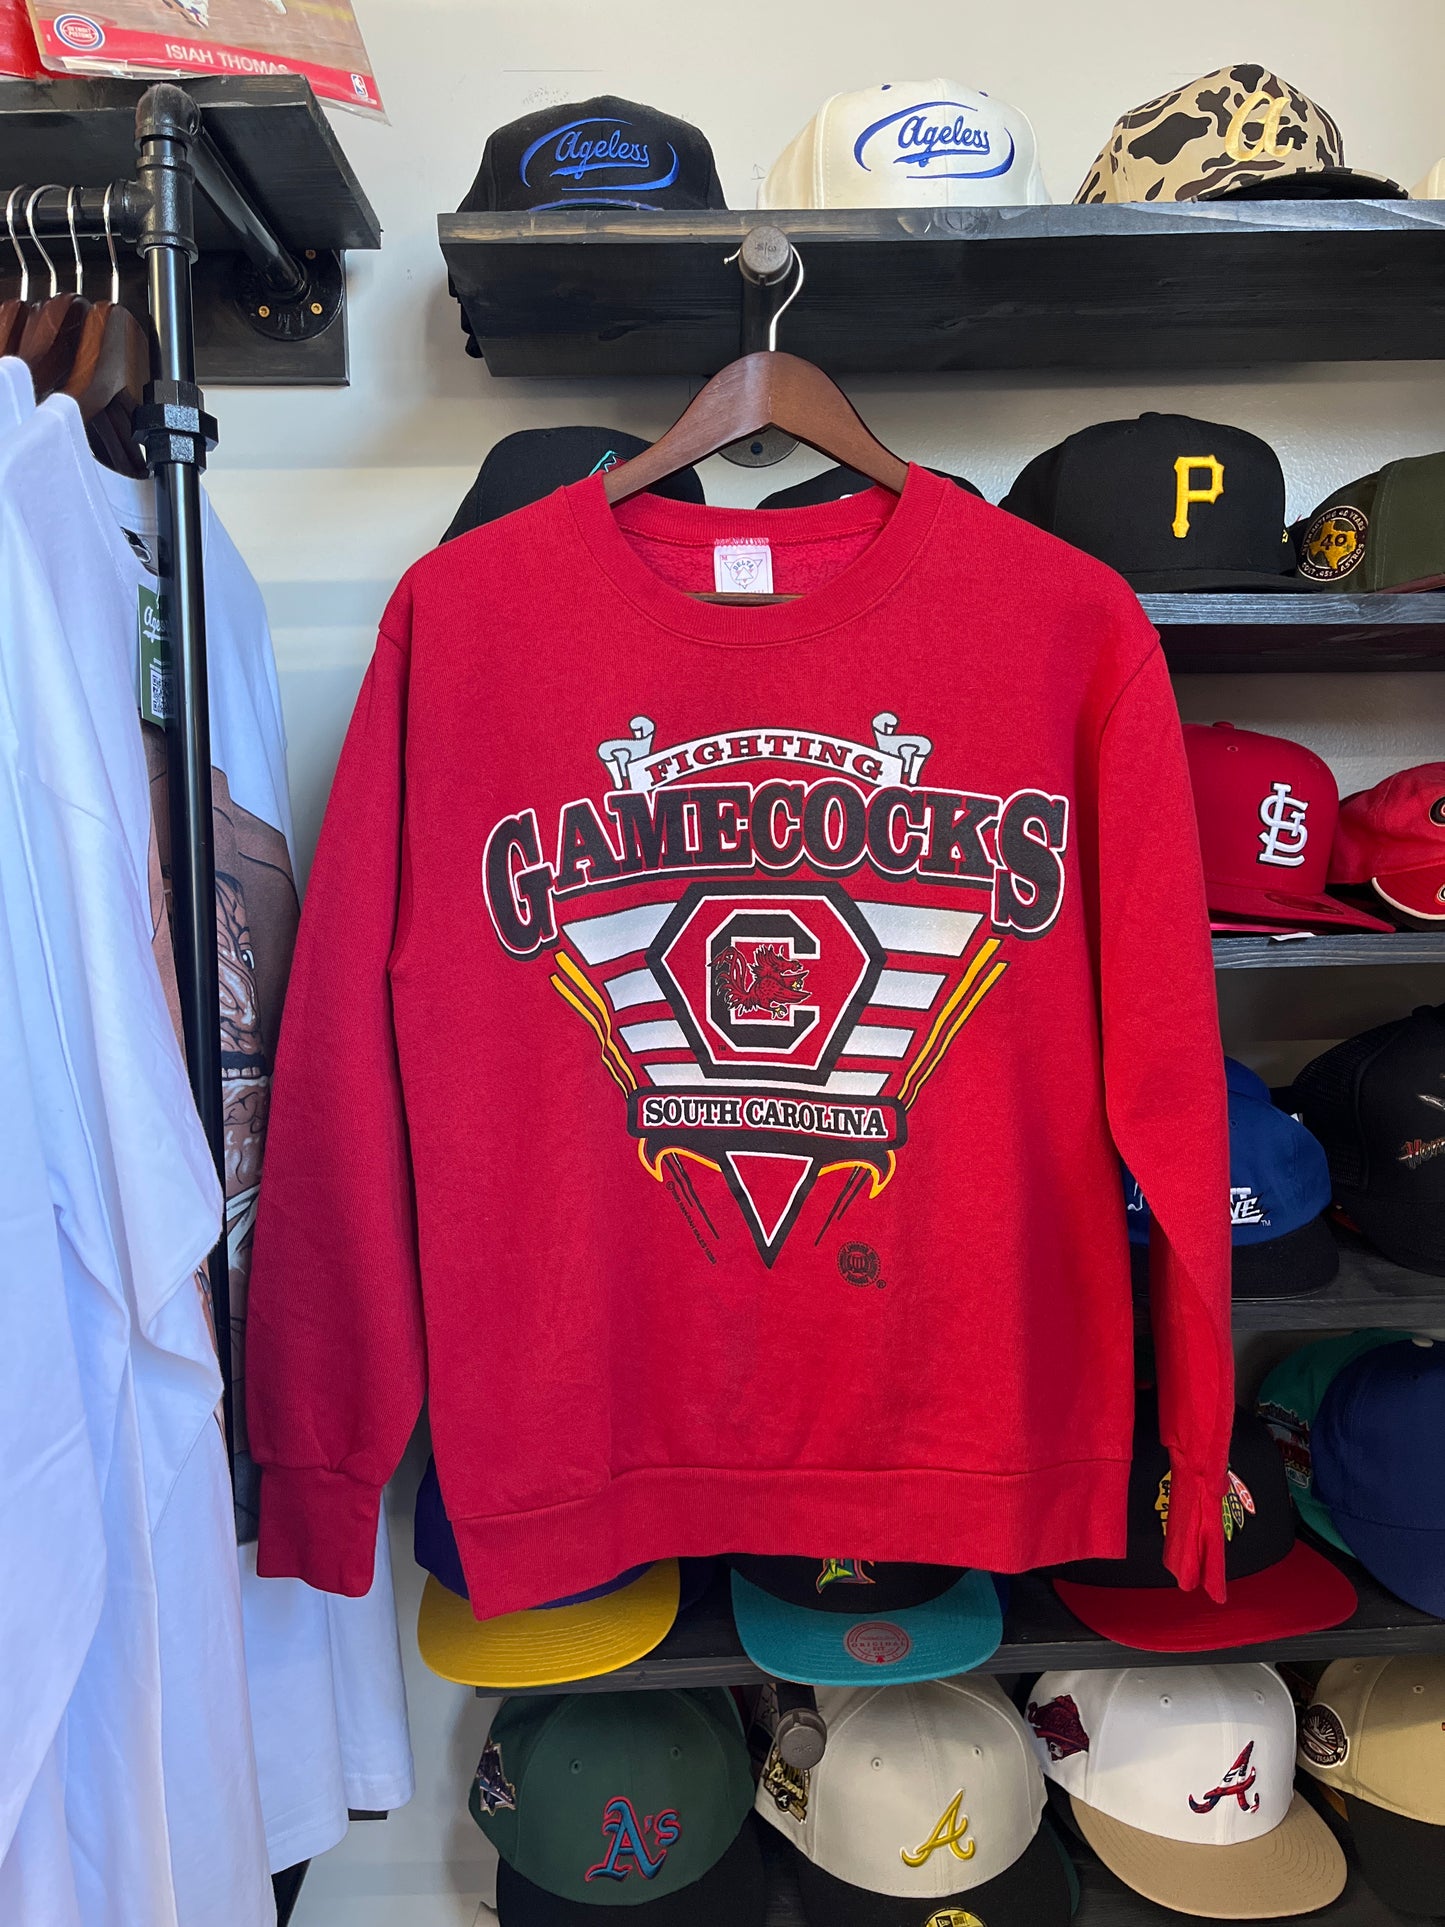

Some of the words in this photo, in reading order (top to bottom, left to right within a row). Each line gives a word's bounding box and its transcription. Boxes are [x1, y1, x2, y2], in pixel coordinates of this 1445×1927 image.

[164, 43, 214, 65] ISIAH
[216, 51, 290, 74] THOMAS
[549, 130, 650, 180] Ageless
[893, 115, 991, 168] Ageless
[1172, 454, 1225, 539] P
[733, 560, 754, 571] DELTA
[1320, 533, 1347, 551] 40
[1340, 543, 1365, 573] ASTROS
[644, 734, 884, 786] FIGHTING
[482, 778, 1069, 959] GAMECOCKS
[643, 1096, 742, 1127] SOUTH
[745, 1100, 888, 1138] CAROLINA
[1188, 1740, 1260, 1815] A
[584, 1796, 682, 1882] A's
[899, 1788, 977, 1868] A
